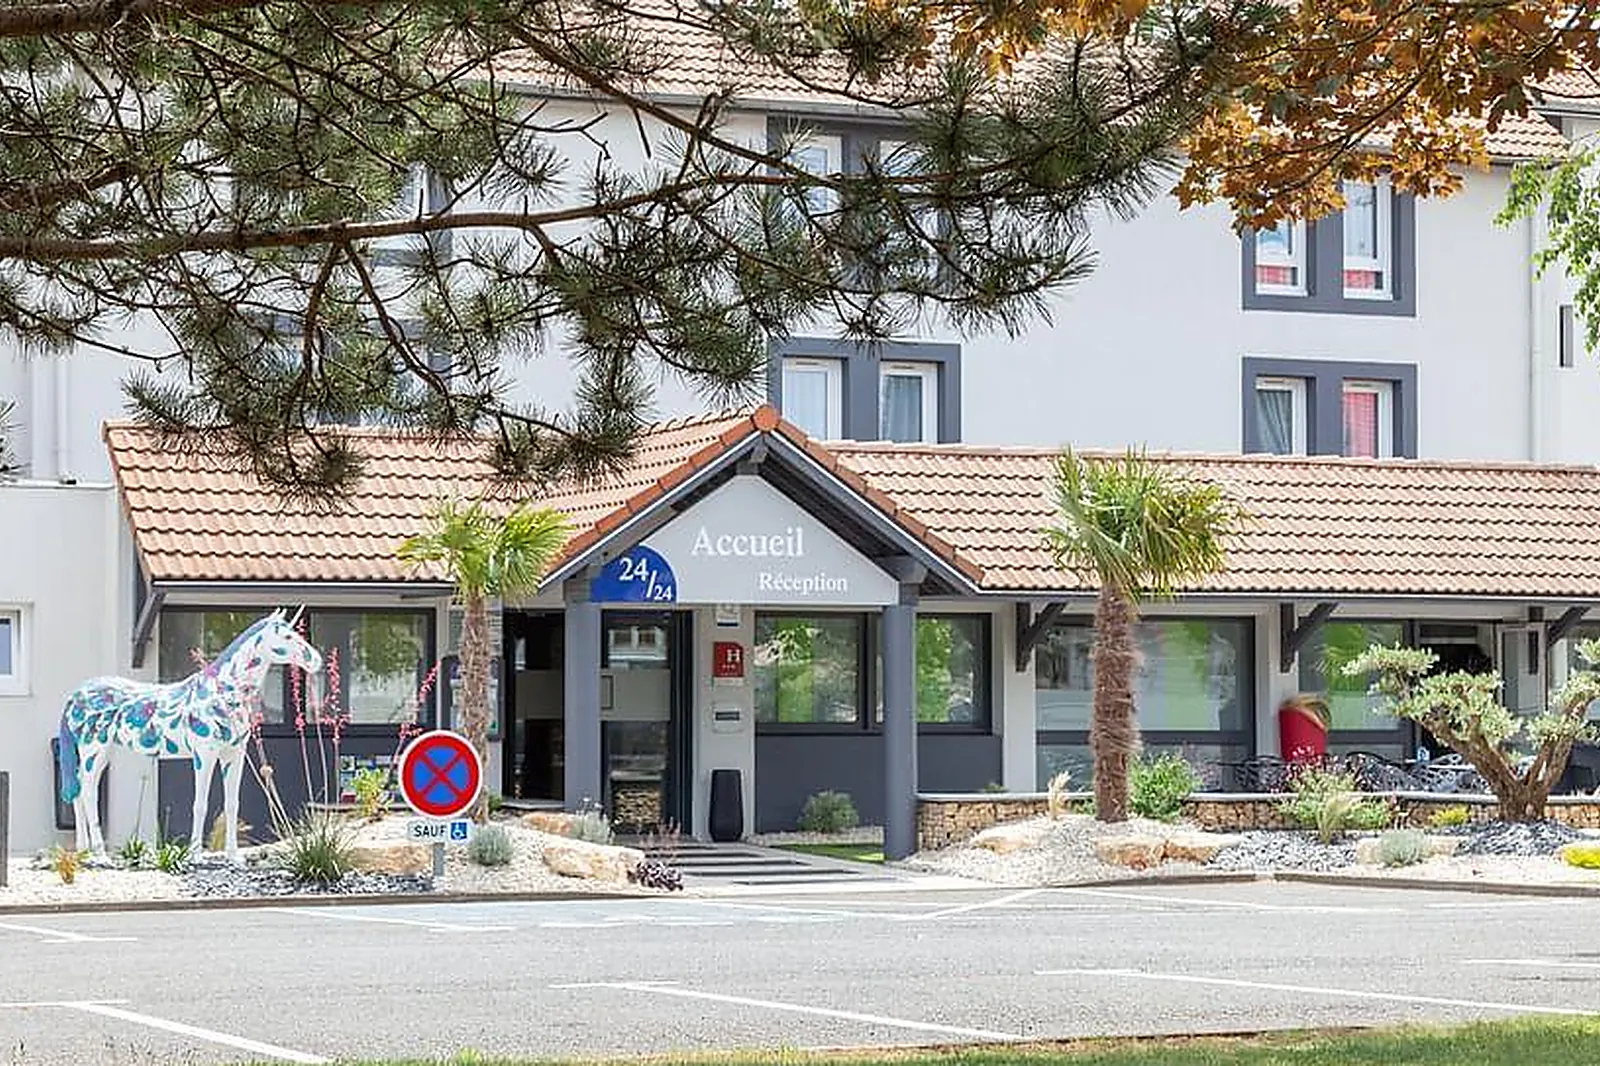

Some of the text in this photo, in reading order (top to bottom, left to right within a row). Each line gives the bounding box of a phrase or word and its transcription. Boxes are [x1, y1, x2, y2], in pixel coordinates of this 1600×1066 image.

[691, 525, 804, 557] Accueil
[758, 571, 848, 596] Réception
[726, 648, 741, 662] H
[413, 824, 448, 838] SAUF
